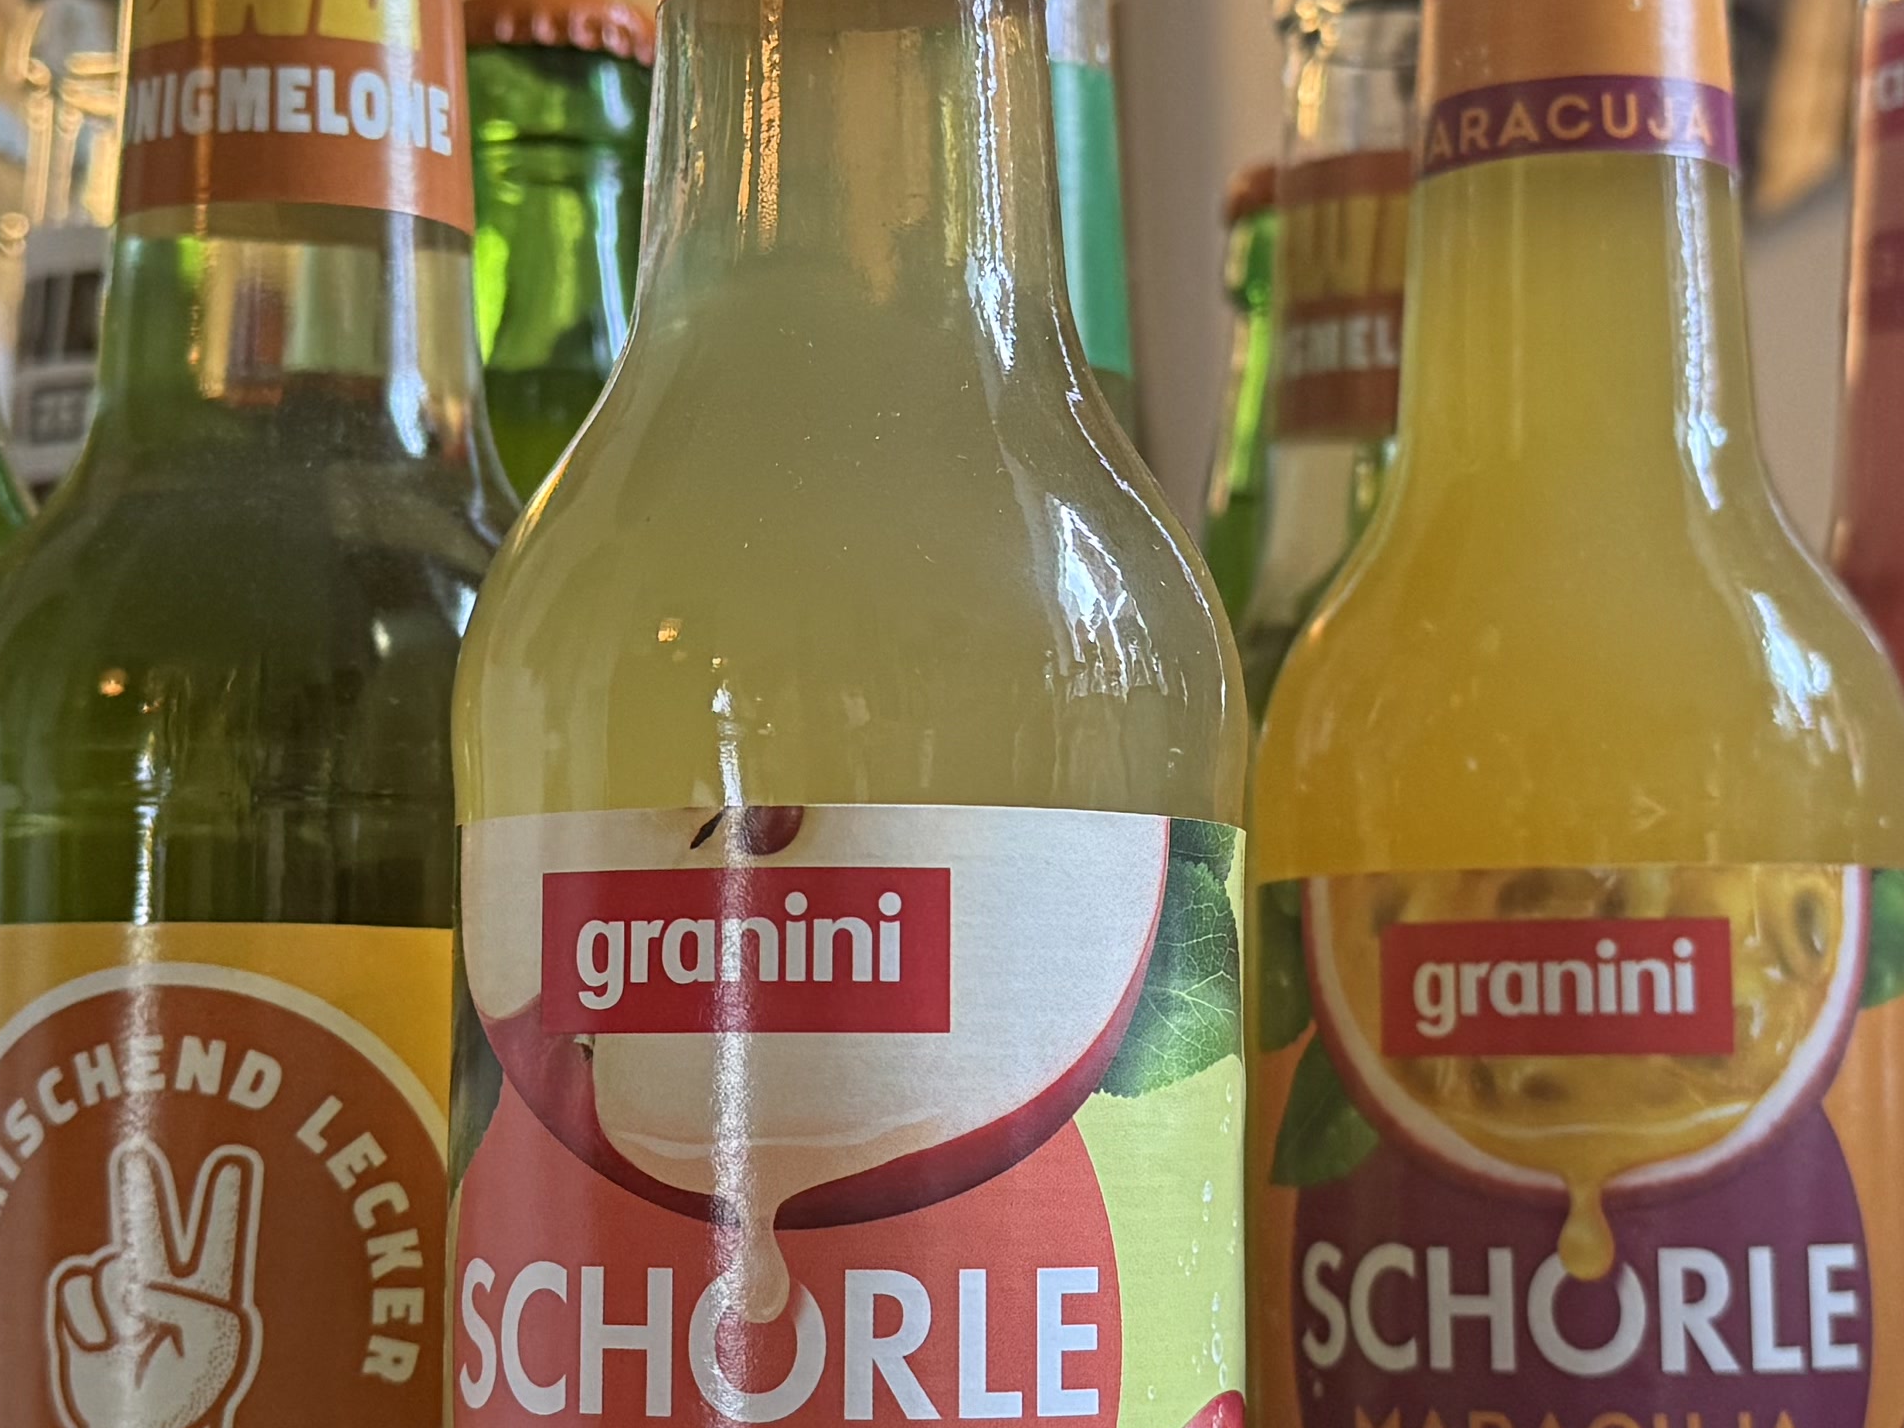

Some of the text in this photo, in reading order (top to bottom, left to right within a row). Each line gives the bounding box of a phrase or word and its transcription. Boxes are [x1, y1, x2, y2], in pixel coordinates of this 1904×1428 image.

[576, 891, 903, 1011] granini
[1411, 936, 1696, 1037] granini
[294, 1094, 426, 1386] LECKER
[1300, 1239, 1864, 1377] SCHORLE
[459, 1257, 1102, 1423] SCHORLE
